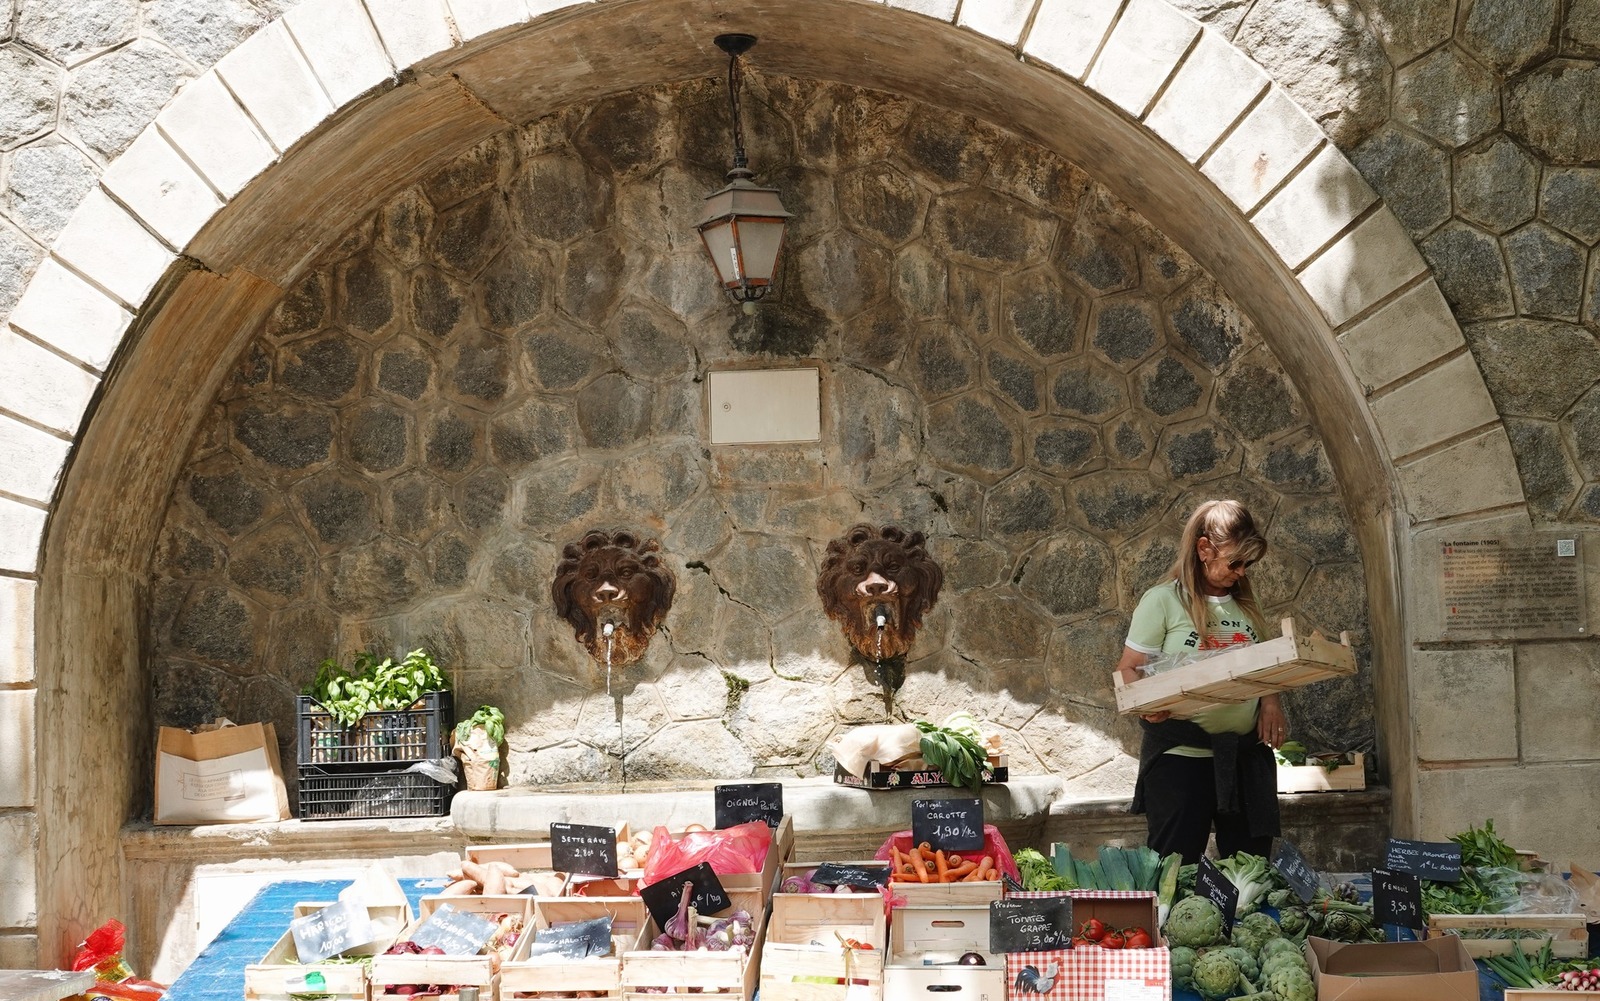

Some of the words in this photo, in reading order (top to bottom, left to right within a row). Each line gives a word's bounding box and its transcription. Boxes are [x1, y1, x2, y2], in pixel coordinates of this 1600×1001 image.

[1221, 620, 1241, 628] ON
[926, 811, 969, 820] CAROTTE
[1390, 900, 1408, 915] 3,50
[1006, 914, 1046, 924] TOMATES
[1019, 922, 1053, 934] GRAPPE
